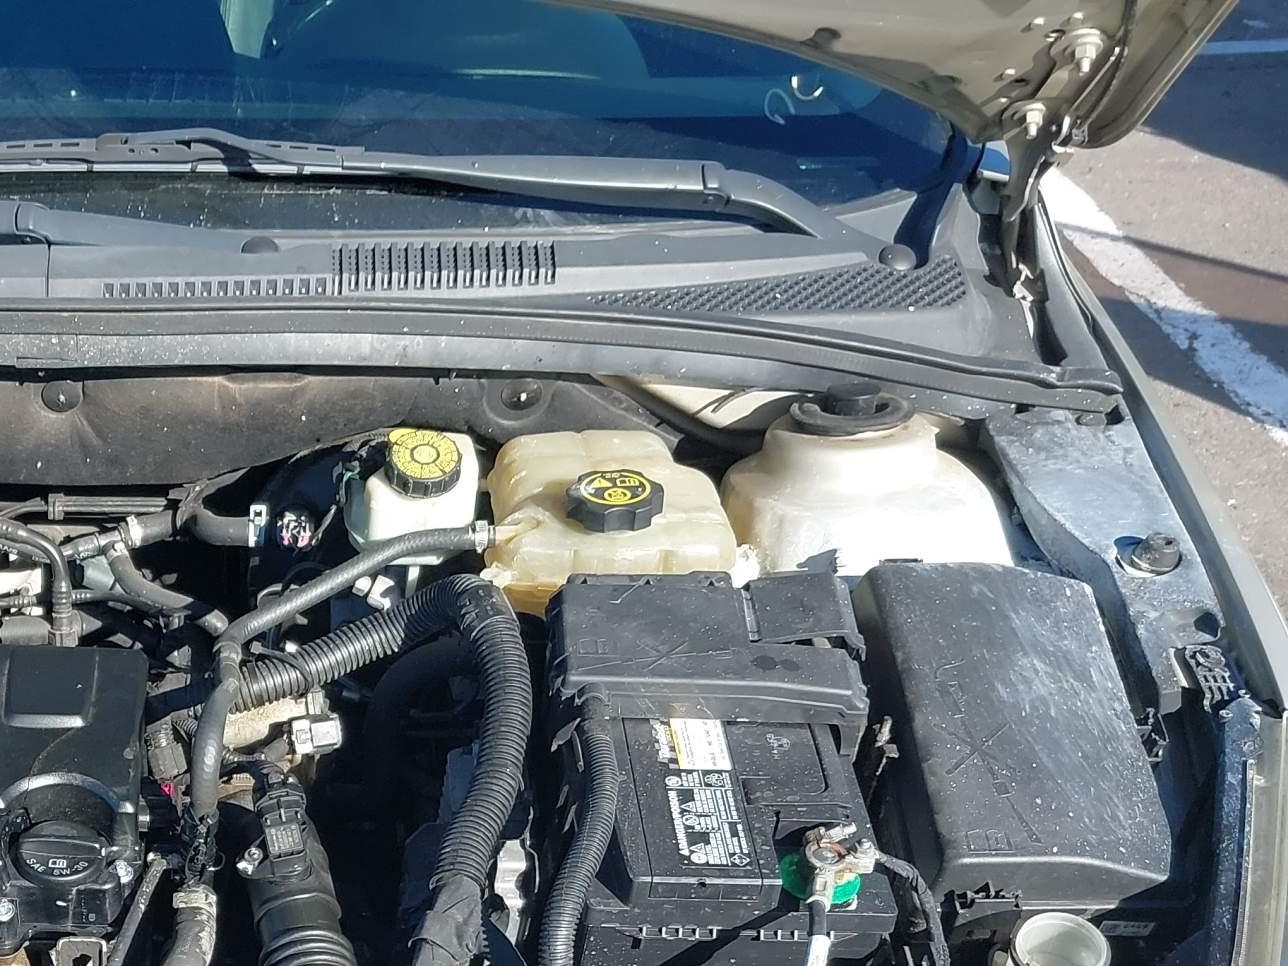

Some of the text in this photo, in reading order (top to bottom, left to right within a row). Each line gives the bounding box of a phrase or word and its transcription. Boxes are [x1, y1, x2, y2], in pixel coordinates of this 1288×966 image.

[668, 790, 687, 849] DANGER/POISON
[26, 858, 89, 876] SAE 5W-30
